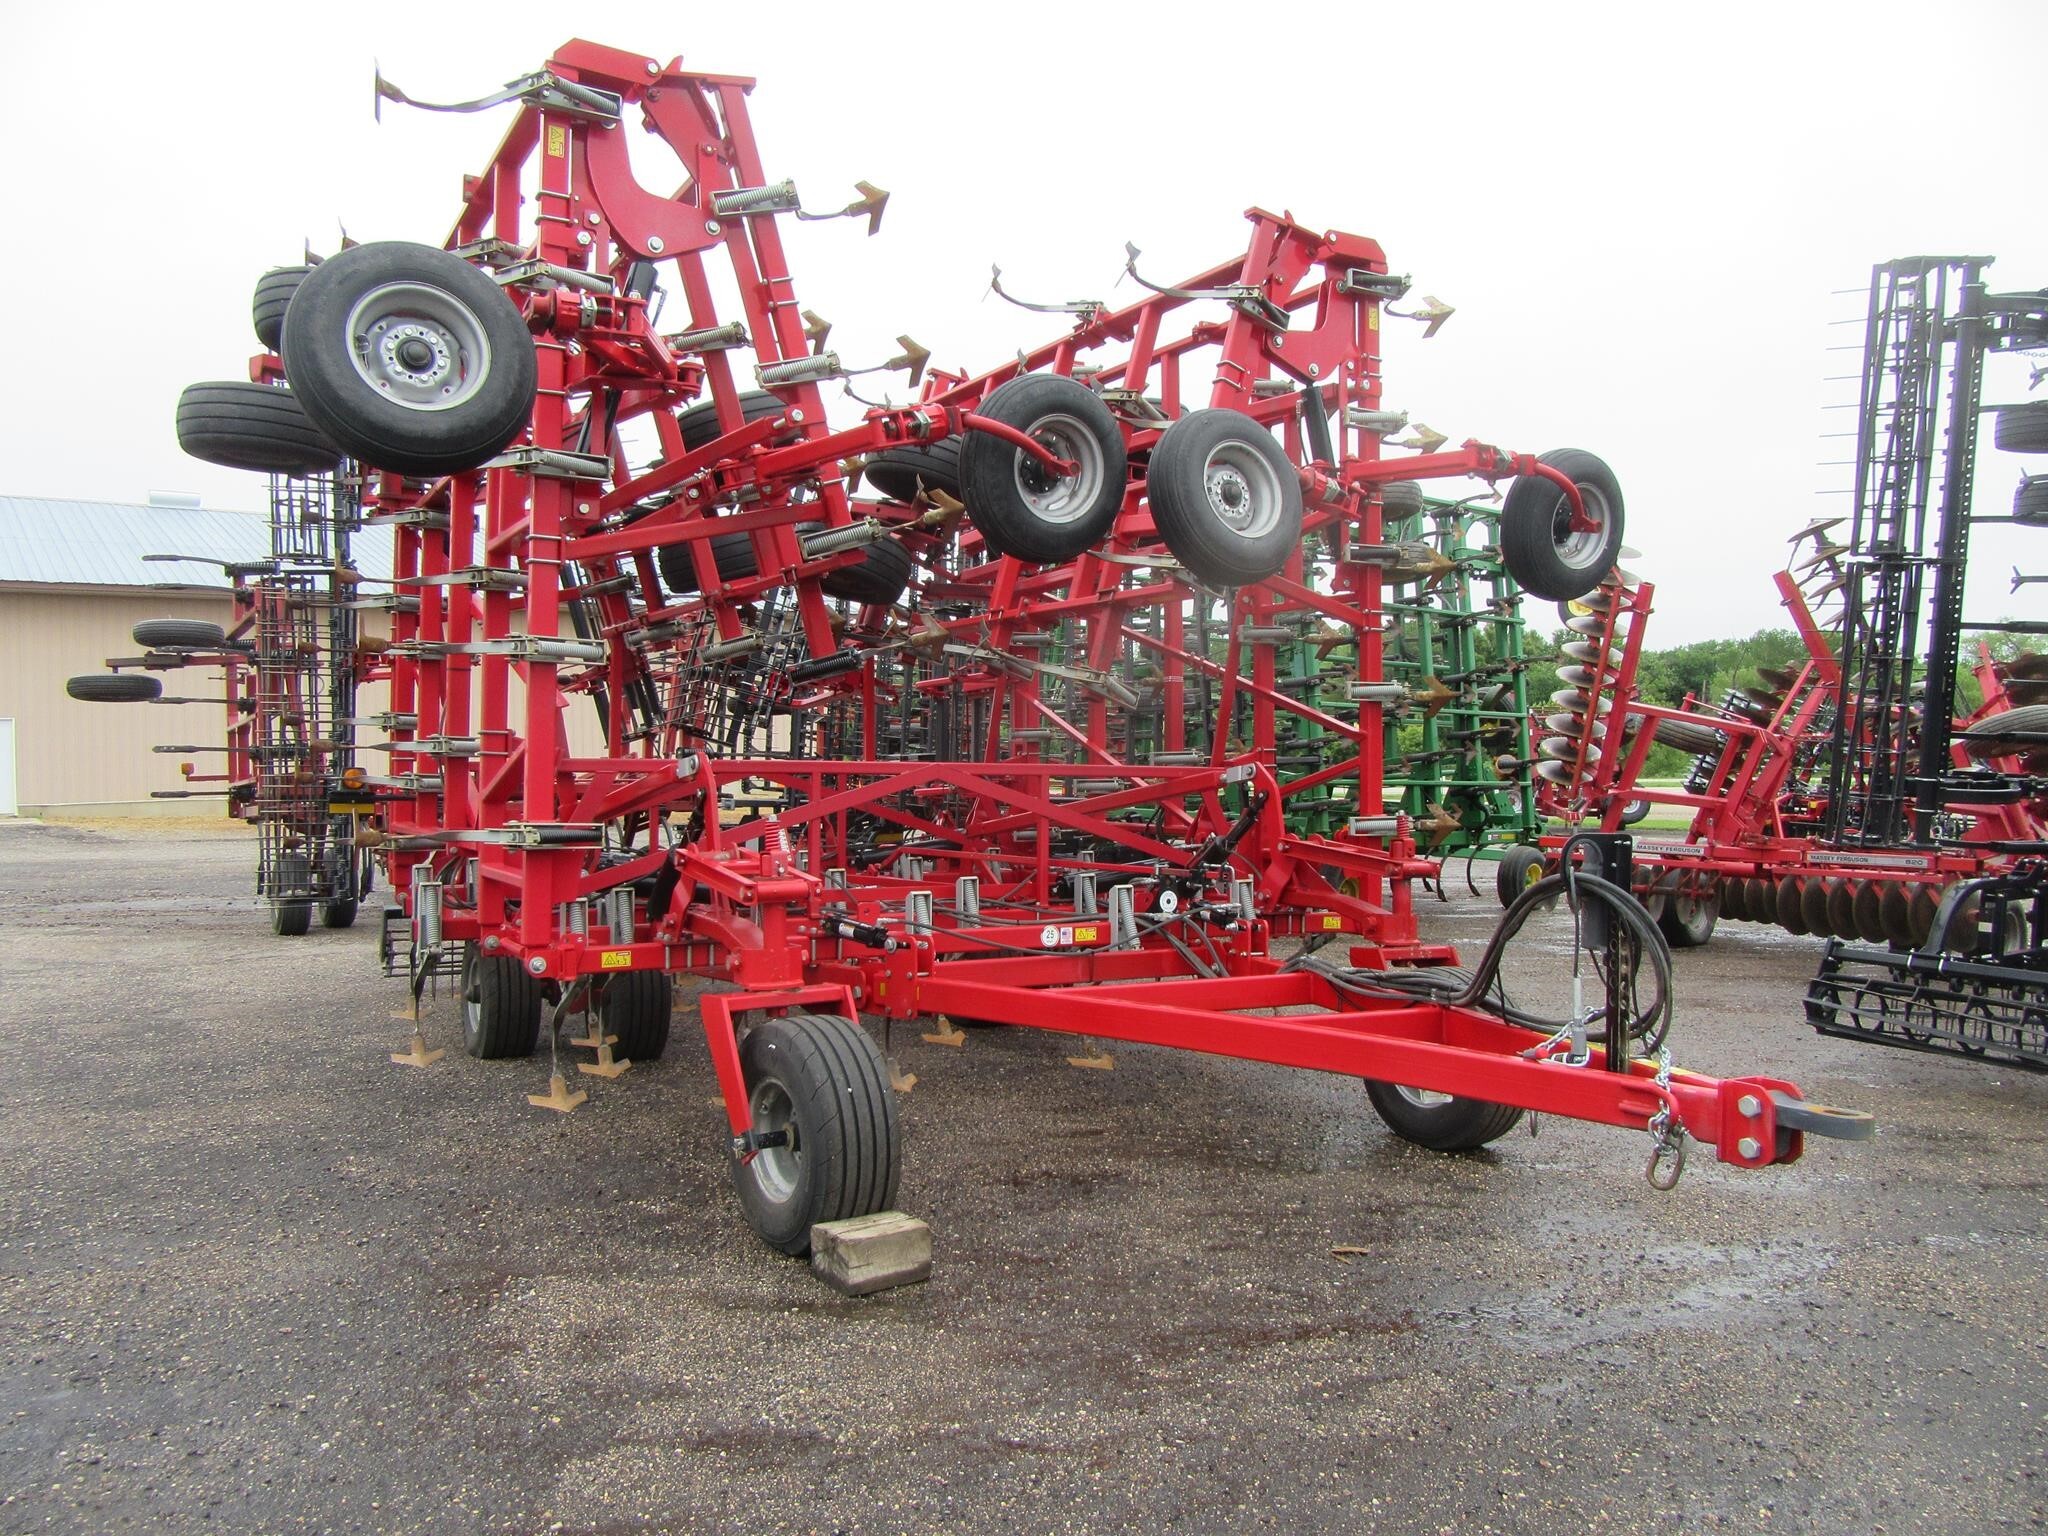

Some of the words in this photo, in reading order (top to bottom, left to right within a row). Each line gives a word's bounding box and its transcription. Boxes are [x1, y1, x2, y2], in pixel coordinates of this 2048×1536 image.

[1665, 846, 1701, 854] FERGUSON
[1836, 855, 1869, 863] FERGUSON
[1046, 929, 1055, 939] 25
